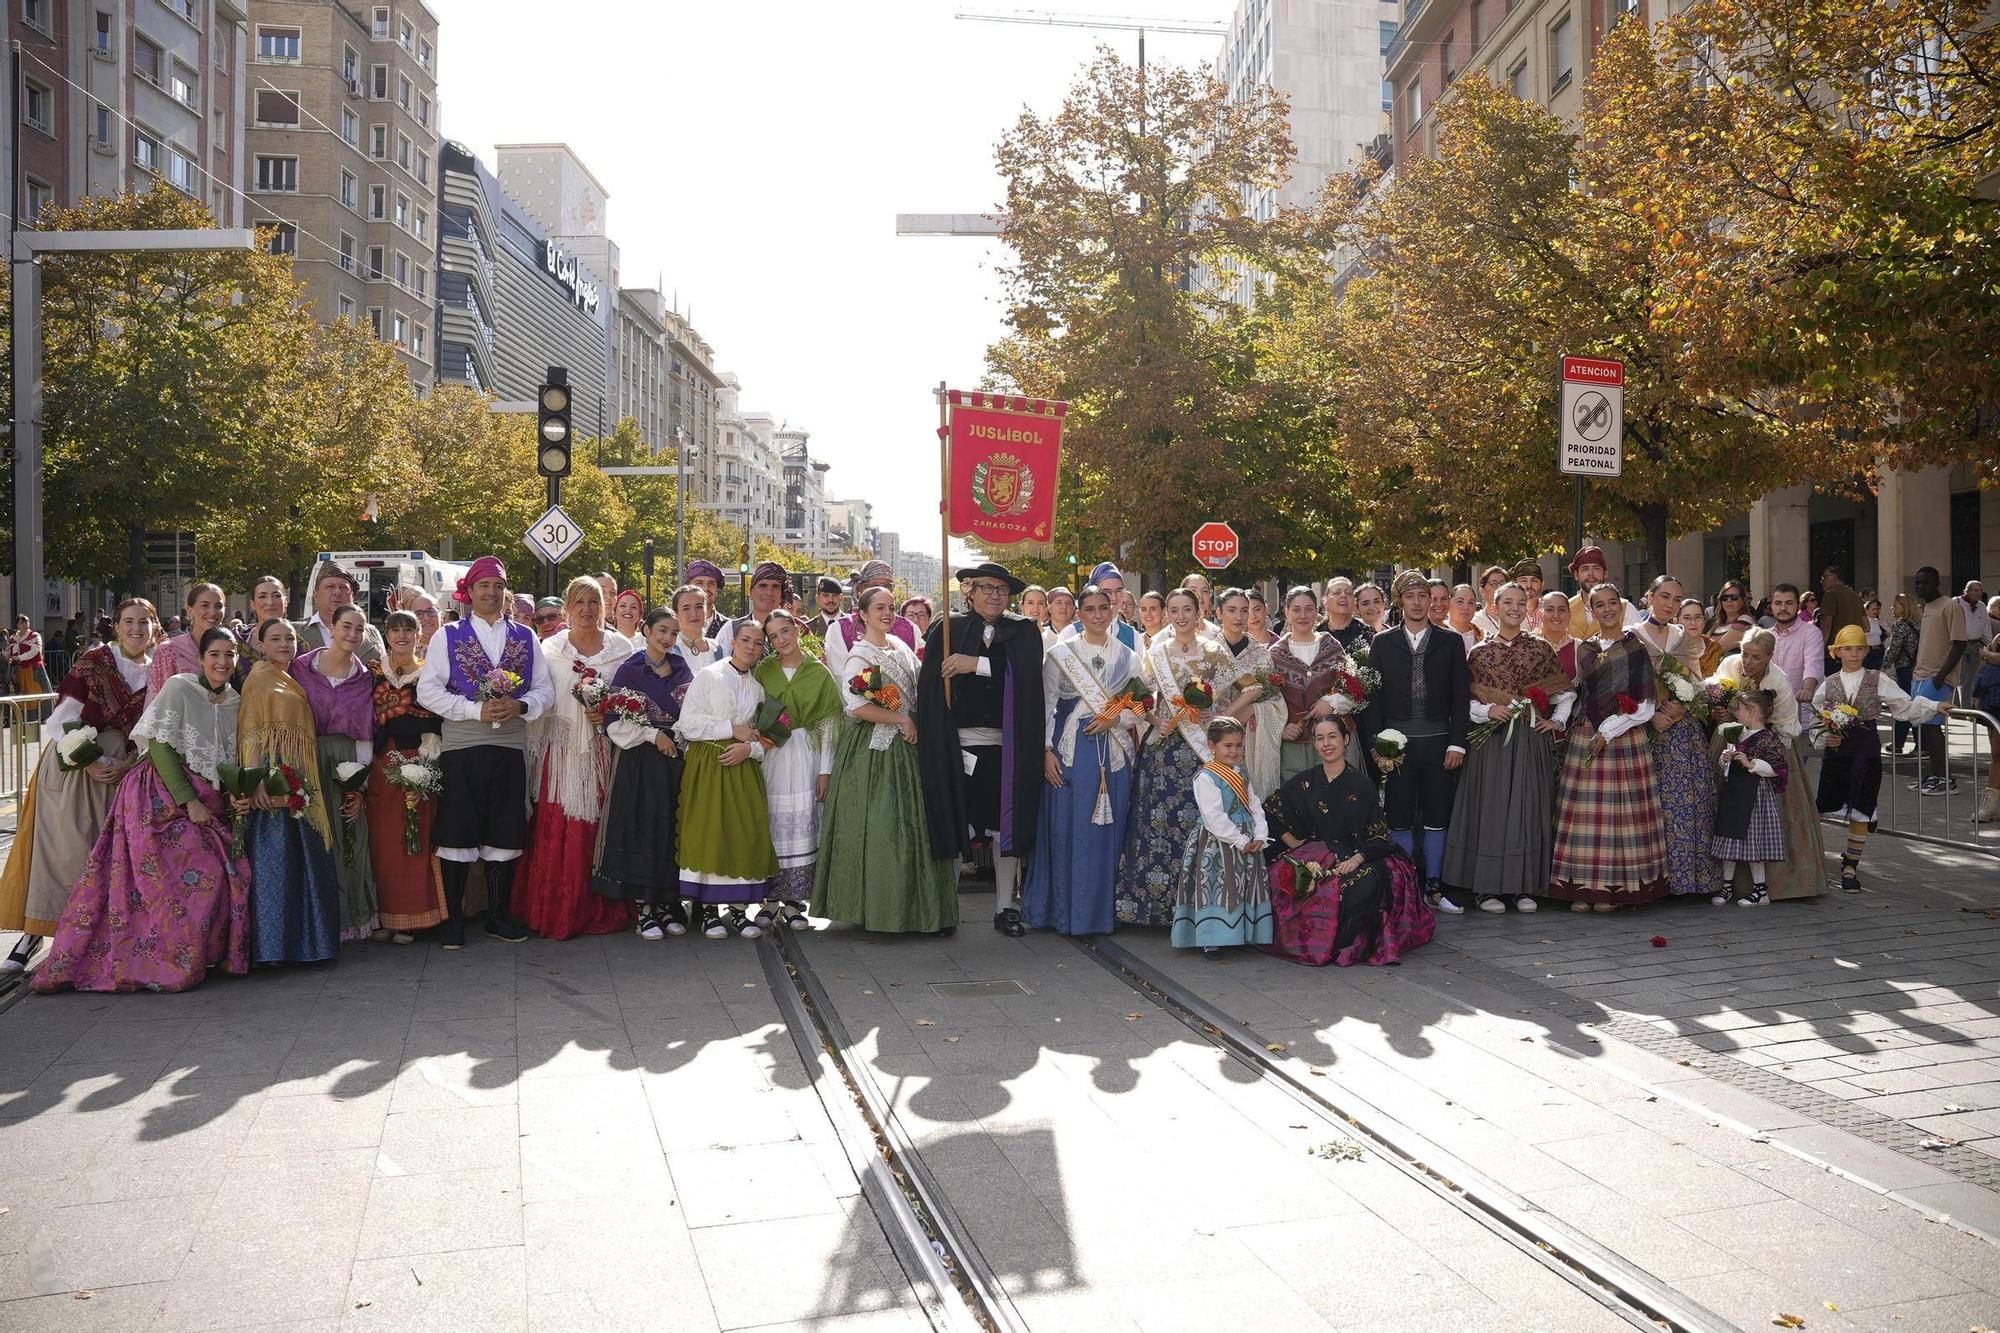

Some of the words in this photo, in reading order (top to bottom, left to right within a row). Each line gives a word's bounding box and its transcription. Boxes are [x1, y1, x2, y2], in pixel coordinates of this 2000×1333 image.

[547, 239, 556, 275] El
[557, 249, 576, 291] Corte
[575, 256, 600, 312] Inglés
[1570, 365, 1617, 378] ATENCIÓN
[1567, 443, 1616, 456] PRIORIDAD
[1568, 457, 1615, 469] PEATONAL
[973, 519, 1027, 532] ZARAGOZA
[542, 523, 568, 544] 30
[1198, 540, 1234, 552] STOP
